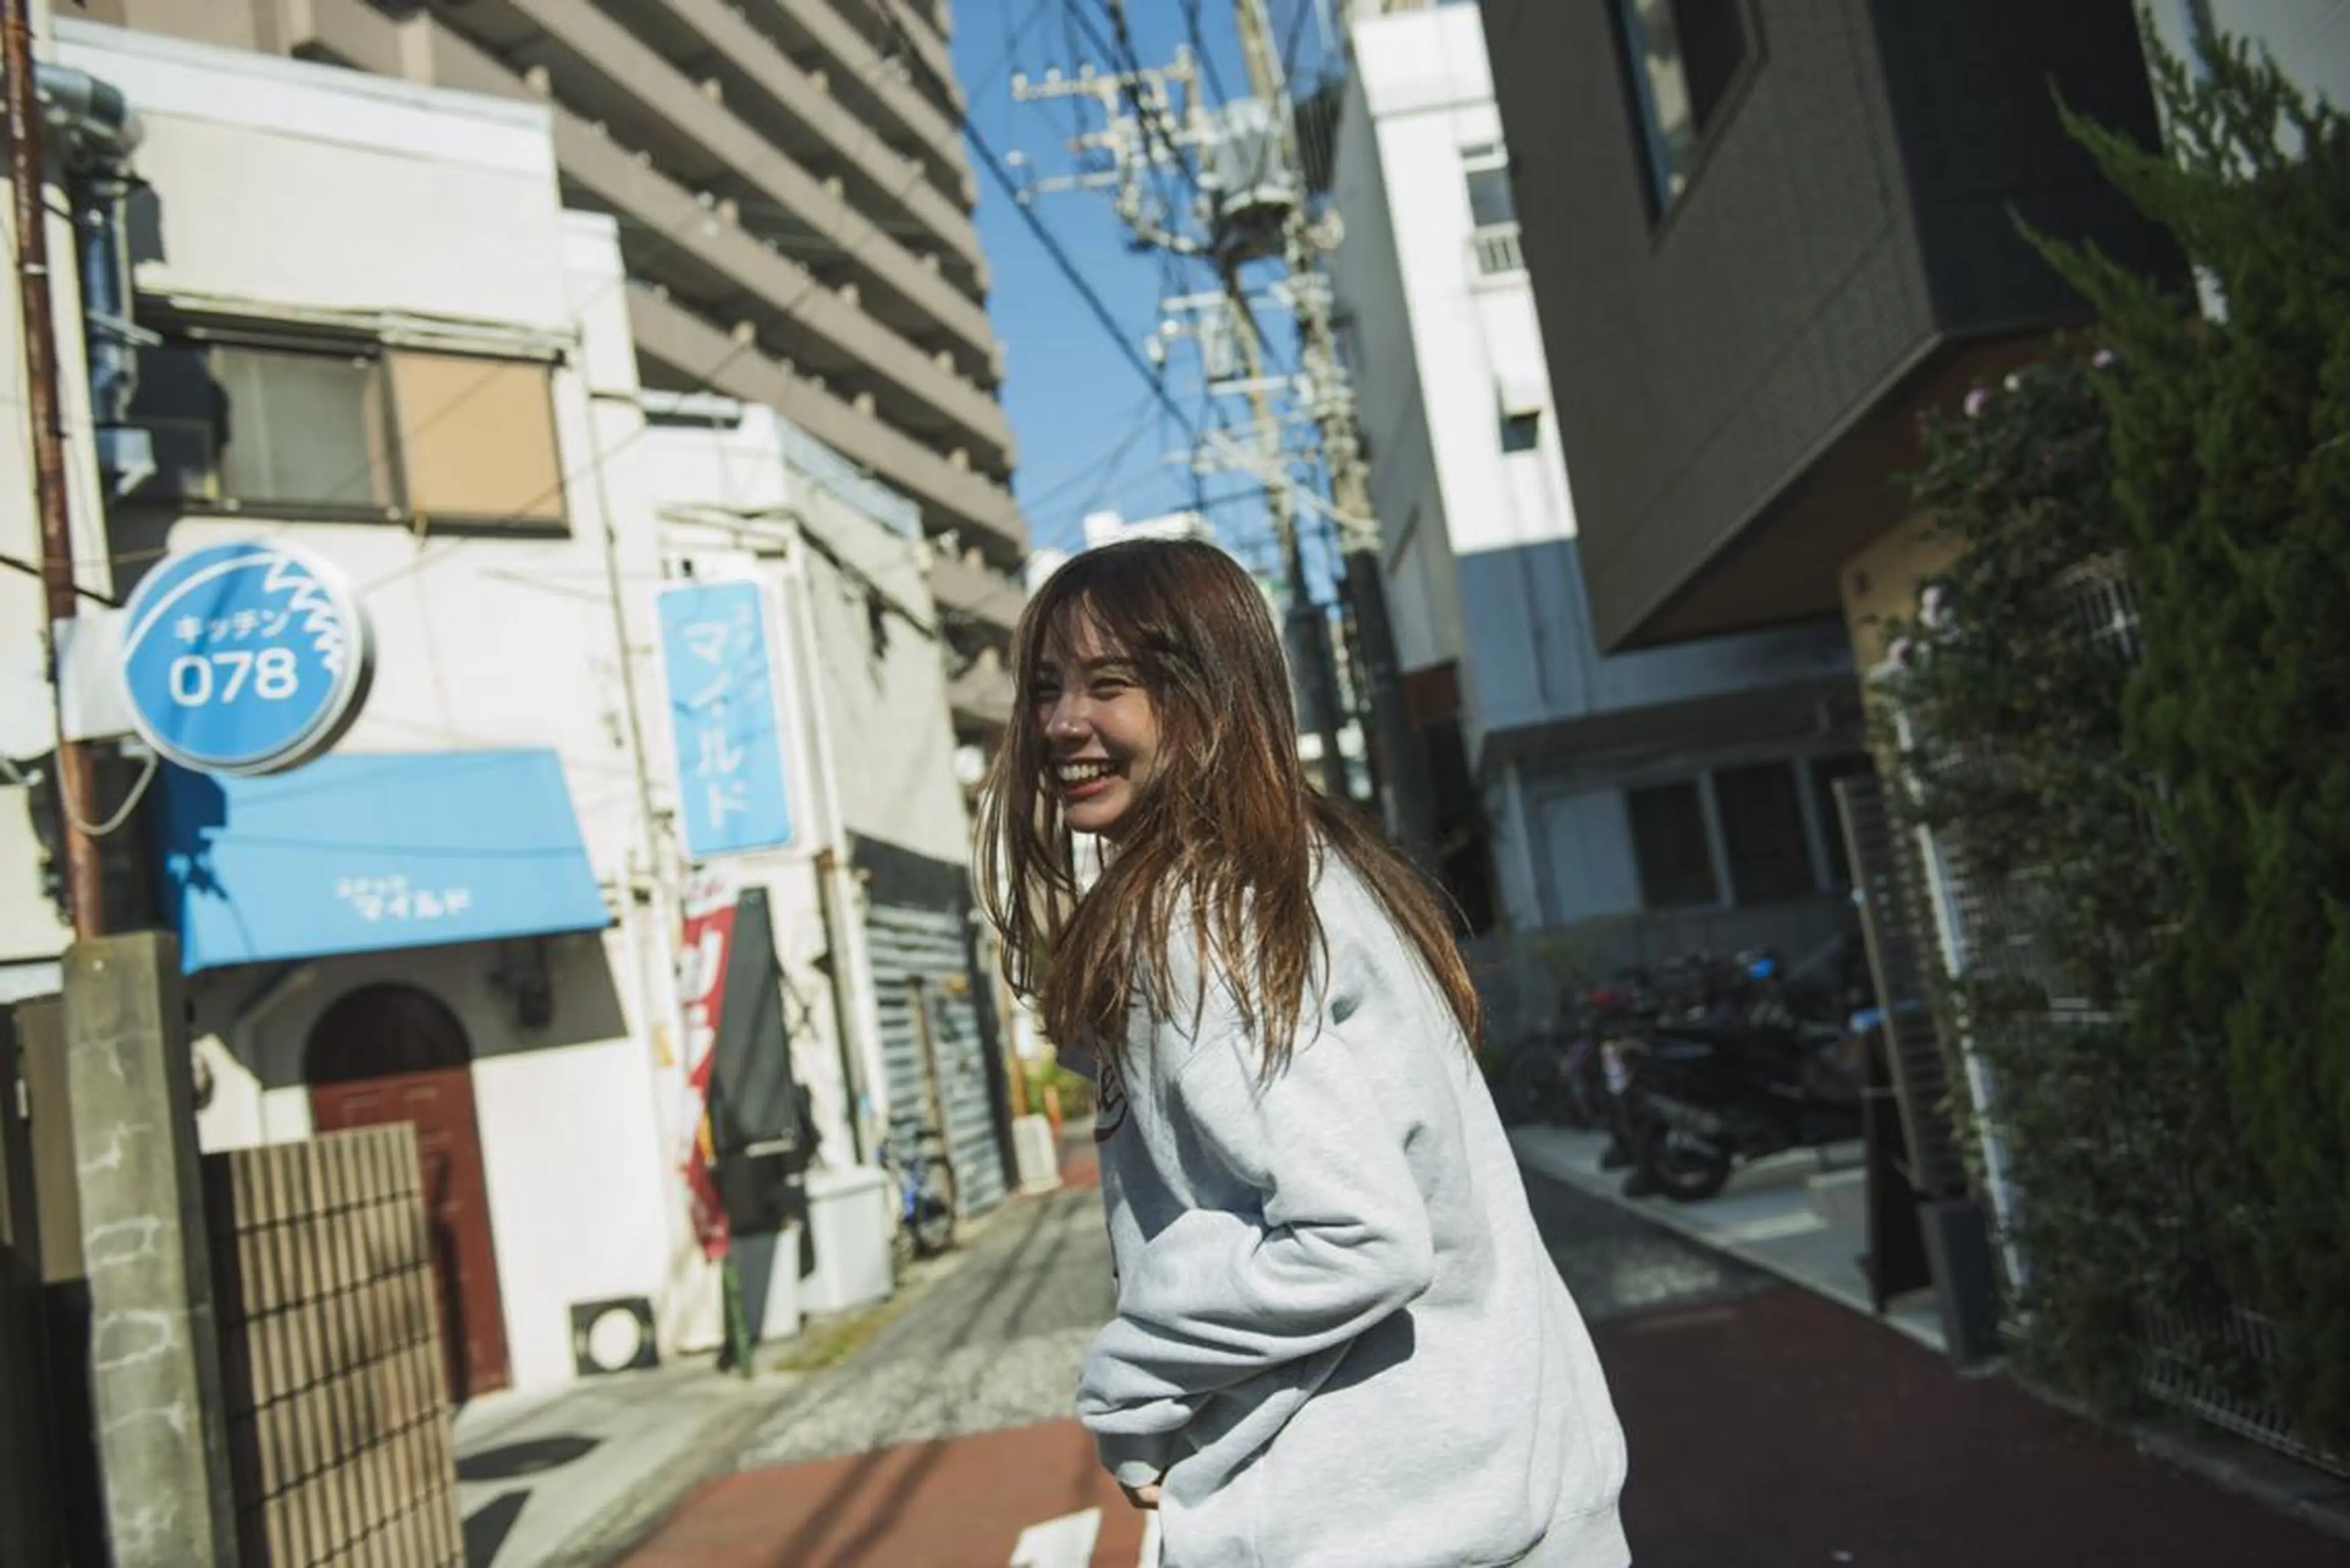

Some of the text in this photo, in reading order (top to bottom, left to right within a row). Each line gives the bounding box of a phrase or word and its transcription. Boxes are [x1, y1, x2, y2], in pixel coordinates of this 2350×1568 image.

[175, 610, 290, 644] キッチン
[170, 648, 298, 707] 078
